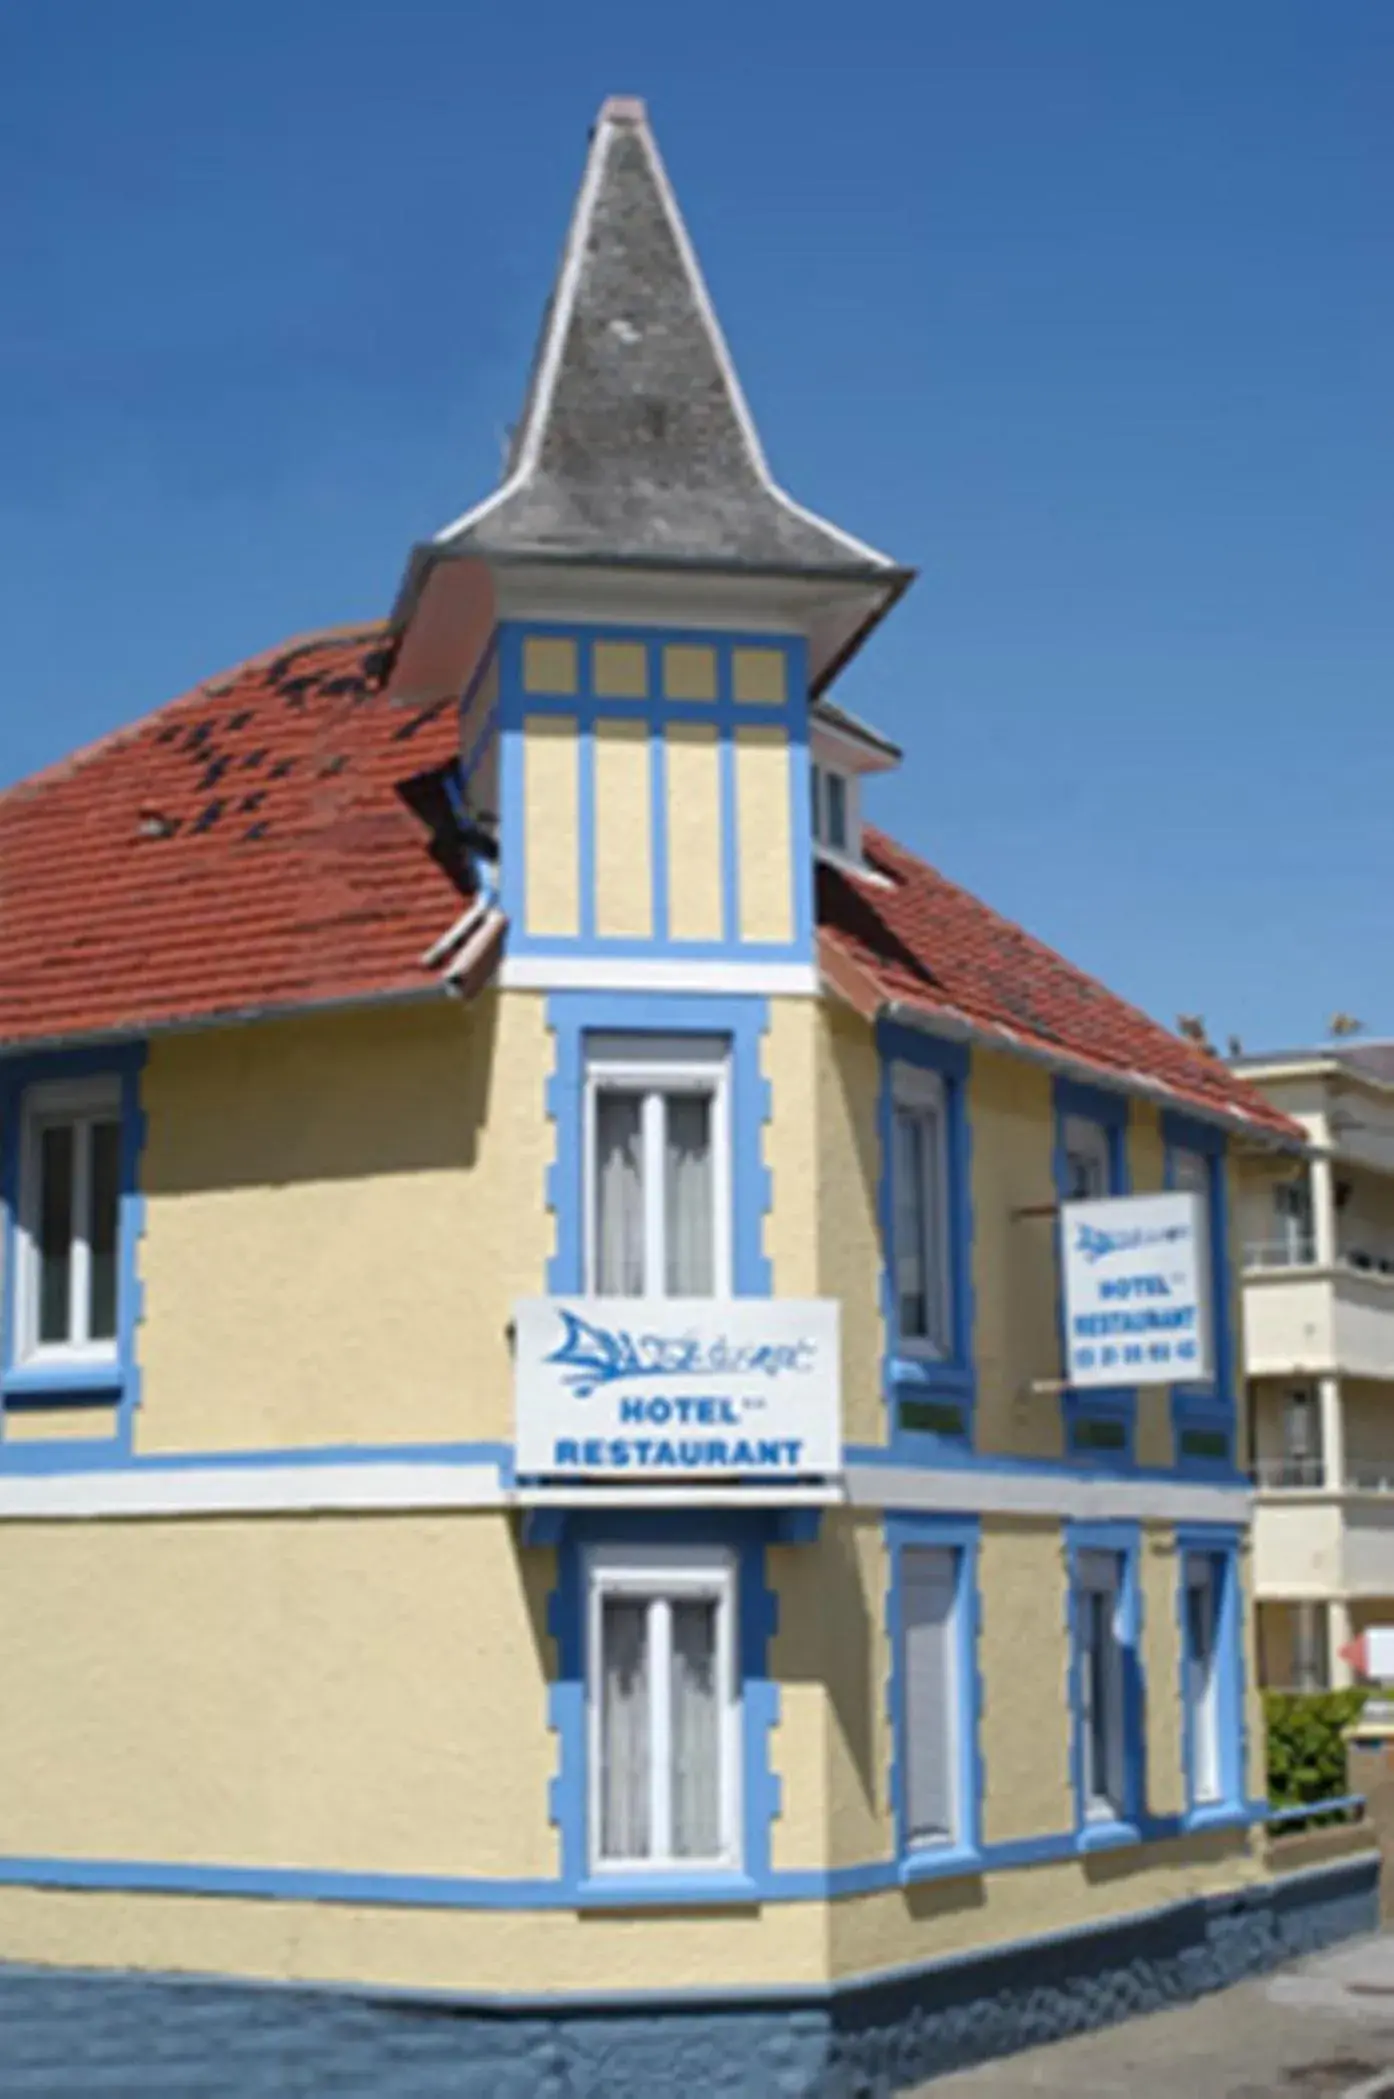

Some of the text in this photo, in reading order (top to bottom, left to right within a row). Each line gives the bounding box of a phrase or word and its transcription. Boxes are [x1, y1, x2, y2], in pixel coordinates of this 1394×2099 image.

[1100, 1274, 1171, 1299] HOTEL
[1074, 1305, 1197, 1337] RESTAURANT
[618, 1396, 740, 1425] HOTEL
[554, 1438, 803, 1467] RESTAURANT
